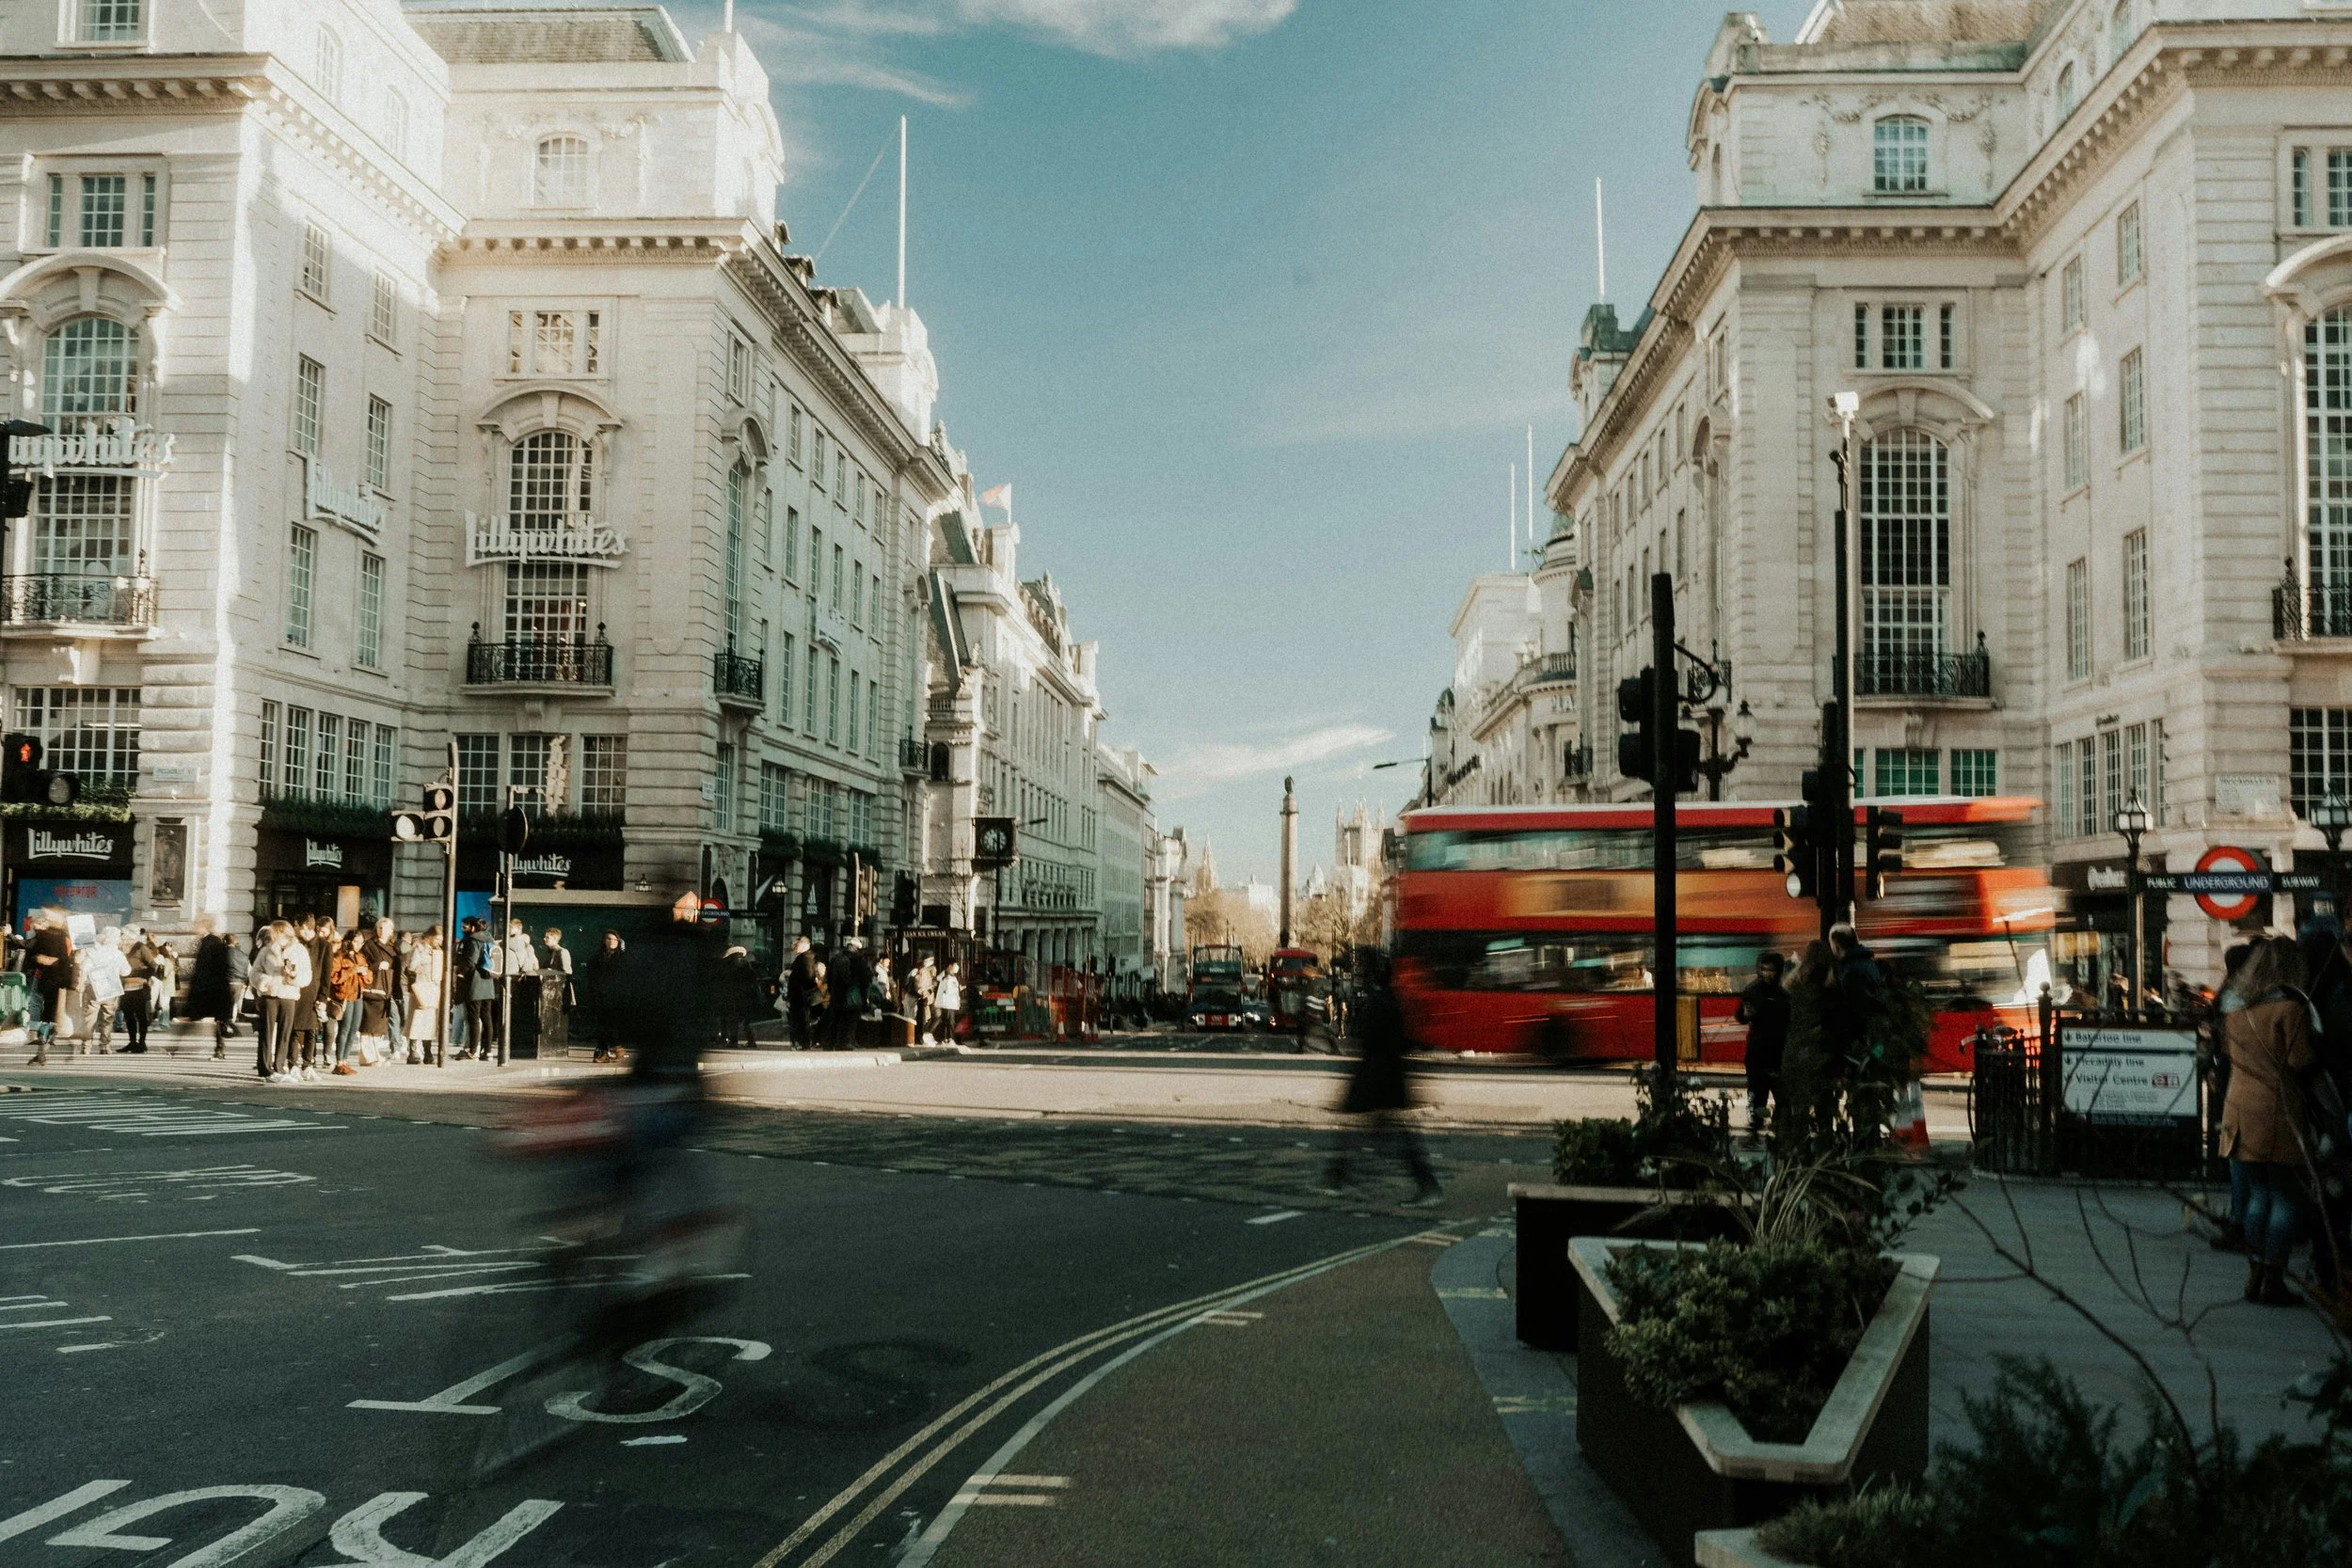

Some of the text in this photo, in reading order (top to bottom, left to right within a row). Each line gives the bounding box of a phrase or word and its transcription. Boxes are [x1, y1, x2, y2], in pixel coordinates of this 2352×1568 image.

[8, 416, 176, 478] llywhites
[465, 509, 630, 568] Lillywhites
[28, 828, 114, 860] Lillywhites
[2146, 876, 2319, 889] PUBLIC UNDERGROUND SUBWAY
[2075, 1032, 2141, 1043] Bakerloo line
[2075, 1056, 2145, 1068] Piccadilly line
[2112, 1073, 2149, 1085] Centre
